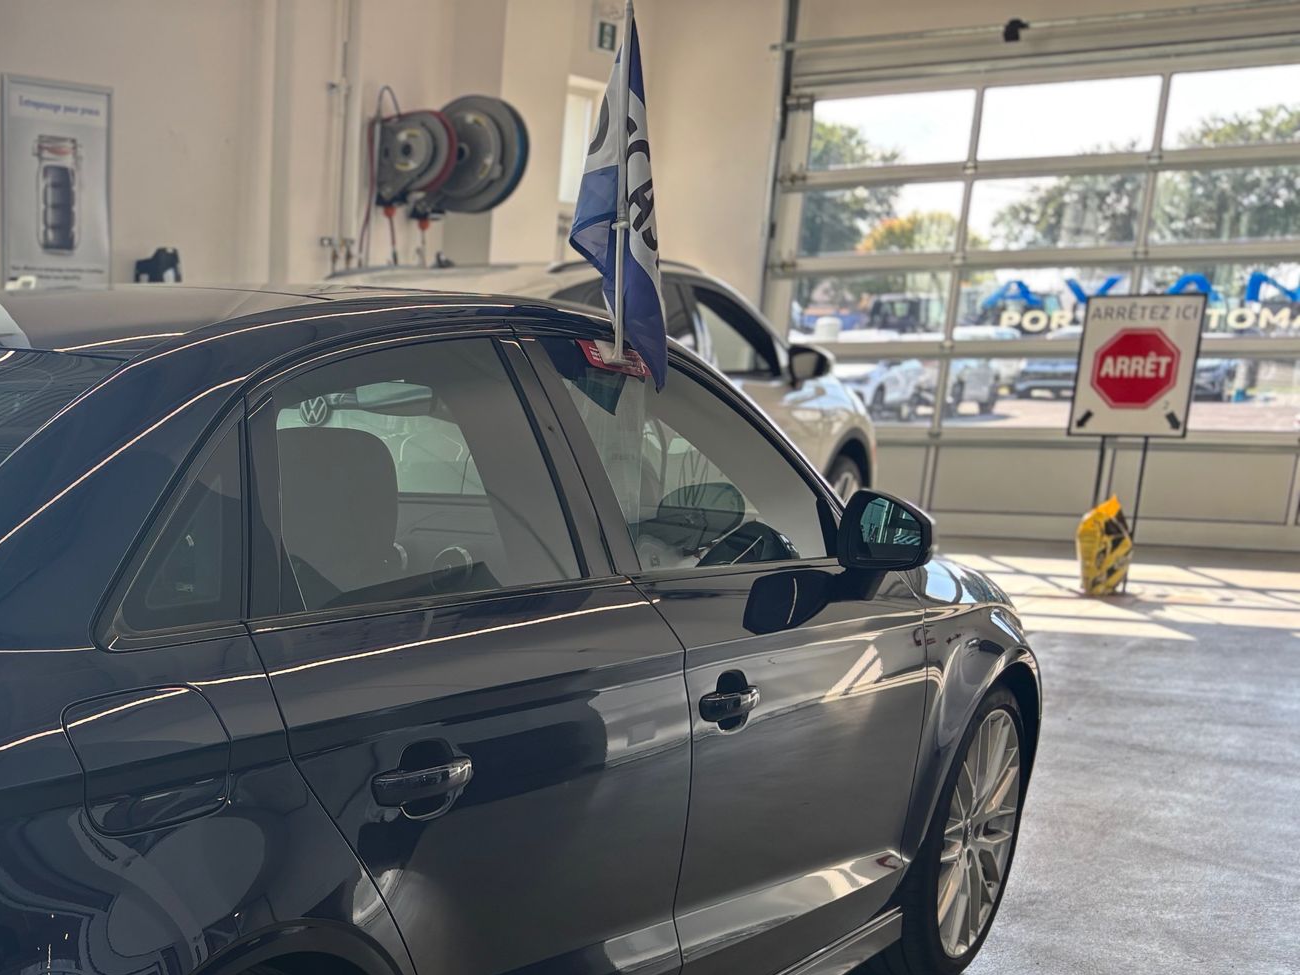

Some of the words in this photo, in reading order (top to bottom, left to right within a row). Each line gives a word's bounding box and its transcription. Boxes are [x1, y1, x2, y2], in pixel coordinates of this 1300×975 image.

[1091, 303, 1170, 321] ARRÊTEZ
[1175, 304, 1199, 319] ICI
[1100, 351, 1171, 379] ARRÊT
